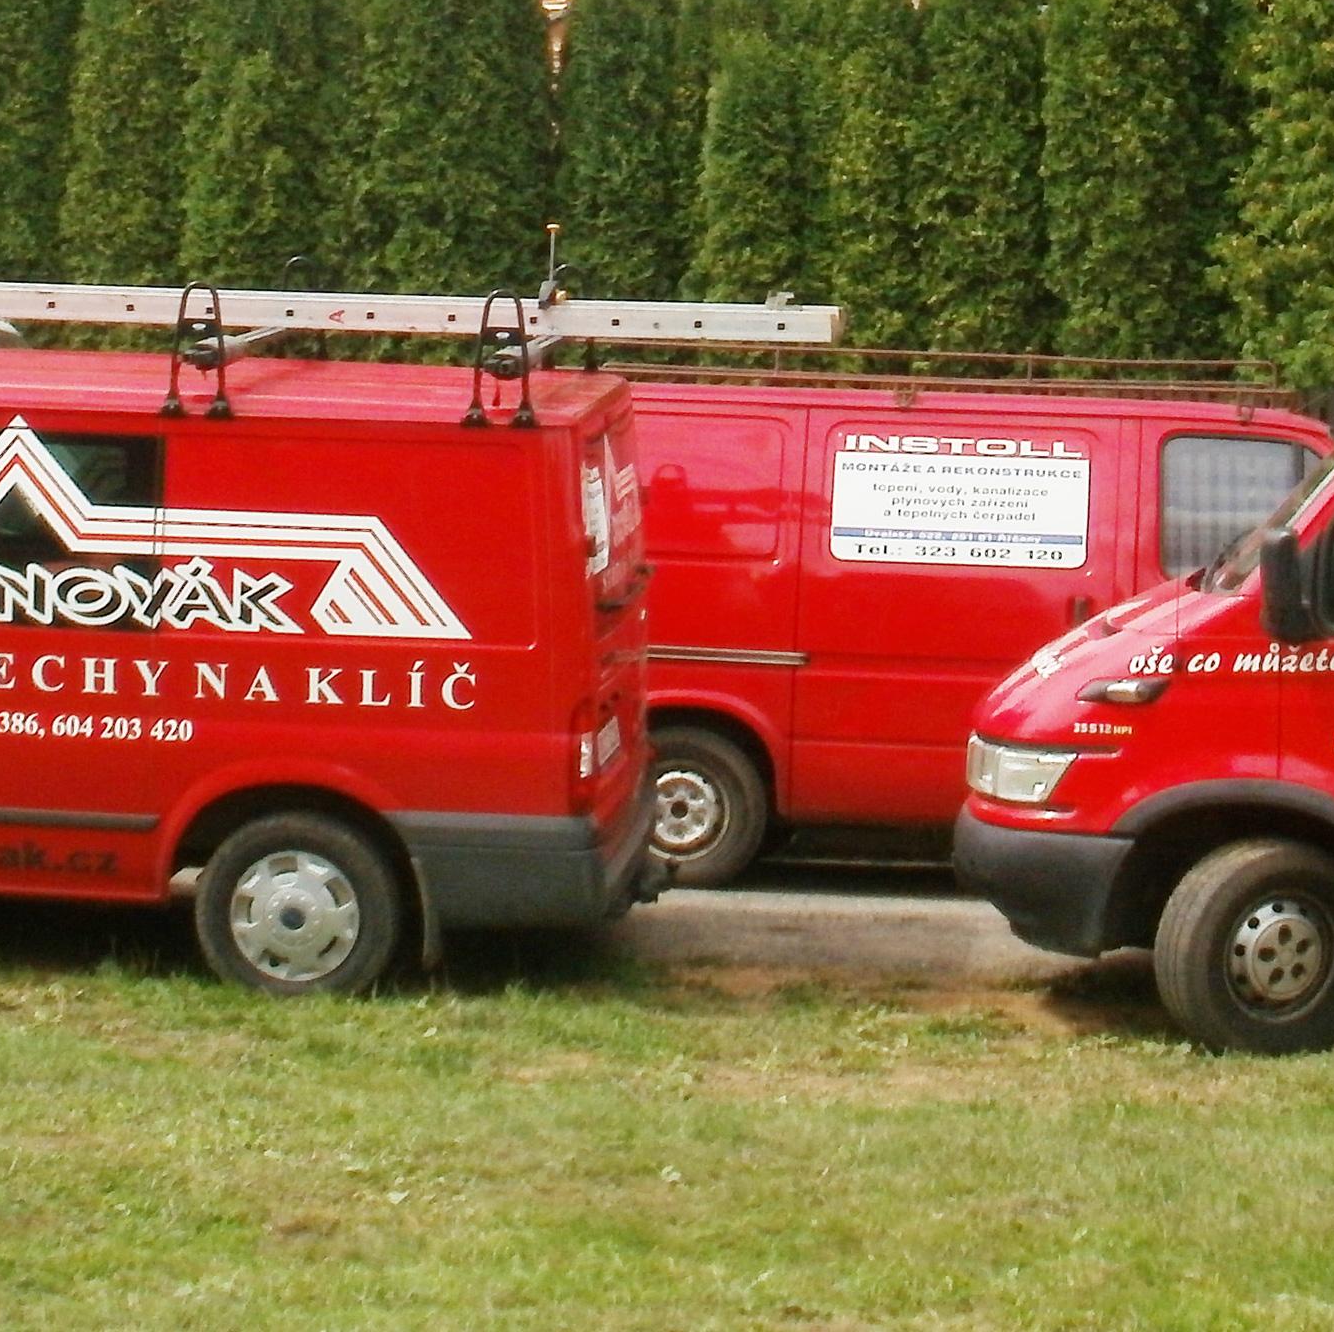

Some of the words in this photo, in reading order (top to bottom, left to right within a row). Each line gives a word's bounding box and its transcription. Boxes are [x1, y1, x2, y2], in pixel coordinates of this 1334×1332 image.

[844, 433, 1084, 459] INSTOLL
[842, 461, 922, 474] MONTÁŽE
[926, 466, 937, 474] A
[941, 466, 1083, 479] REKONSTRUKCE
[972, 485, 1048, 497] kanalizace
[883, 509, 891, 517] a
[854, 542, 903, 556] Tel.:
[914, 545, 957, 558] 323
[969, 547, 1011, 559] 602
[1025, 549, 1064, 561] 120
[1128, 645, 1175, 674] vše
[1187, 653, 1220, 674] co
[194, 662, 285, 703] NA
[304, 662, 477, 711] KLÍČ
[51, 714, 94, 739] 604
[99, 716, 143, 741] 203
[149, 718, 194, 742] 420
